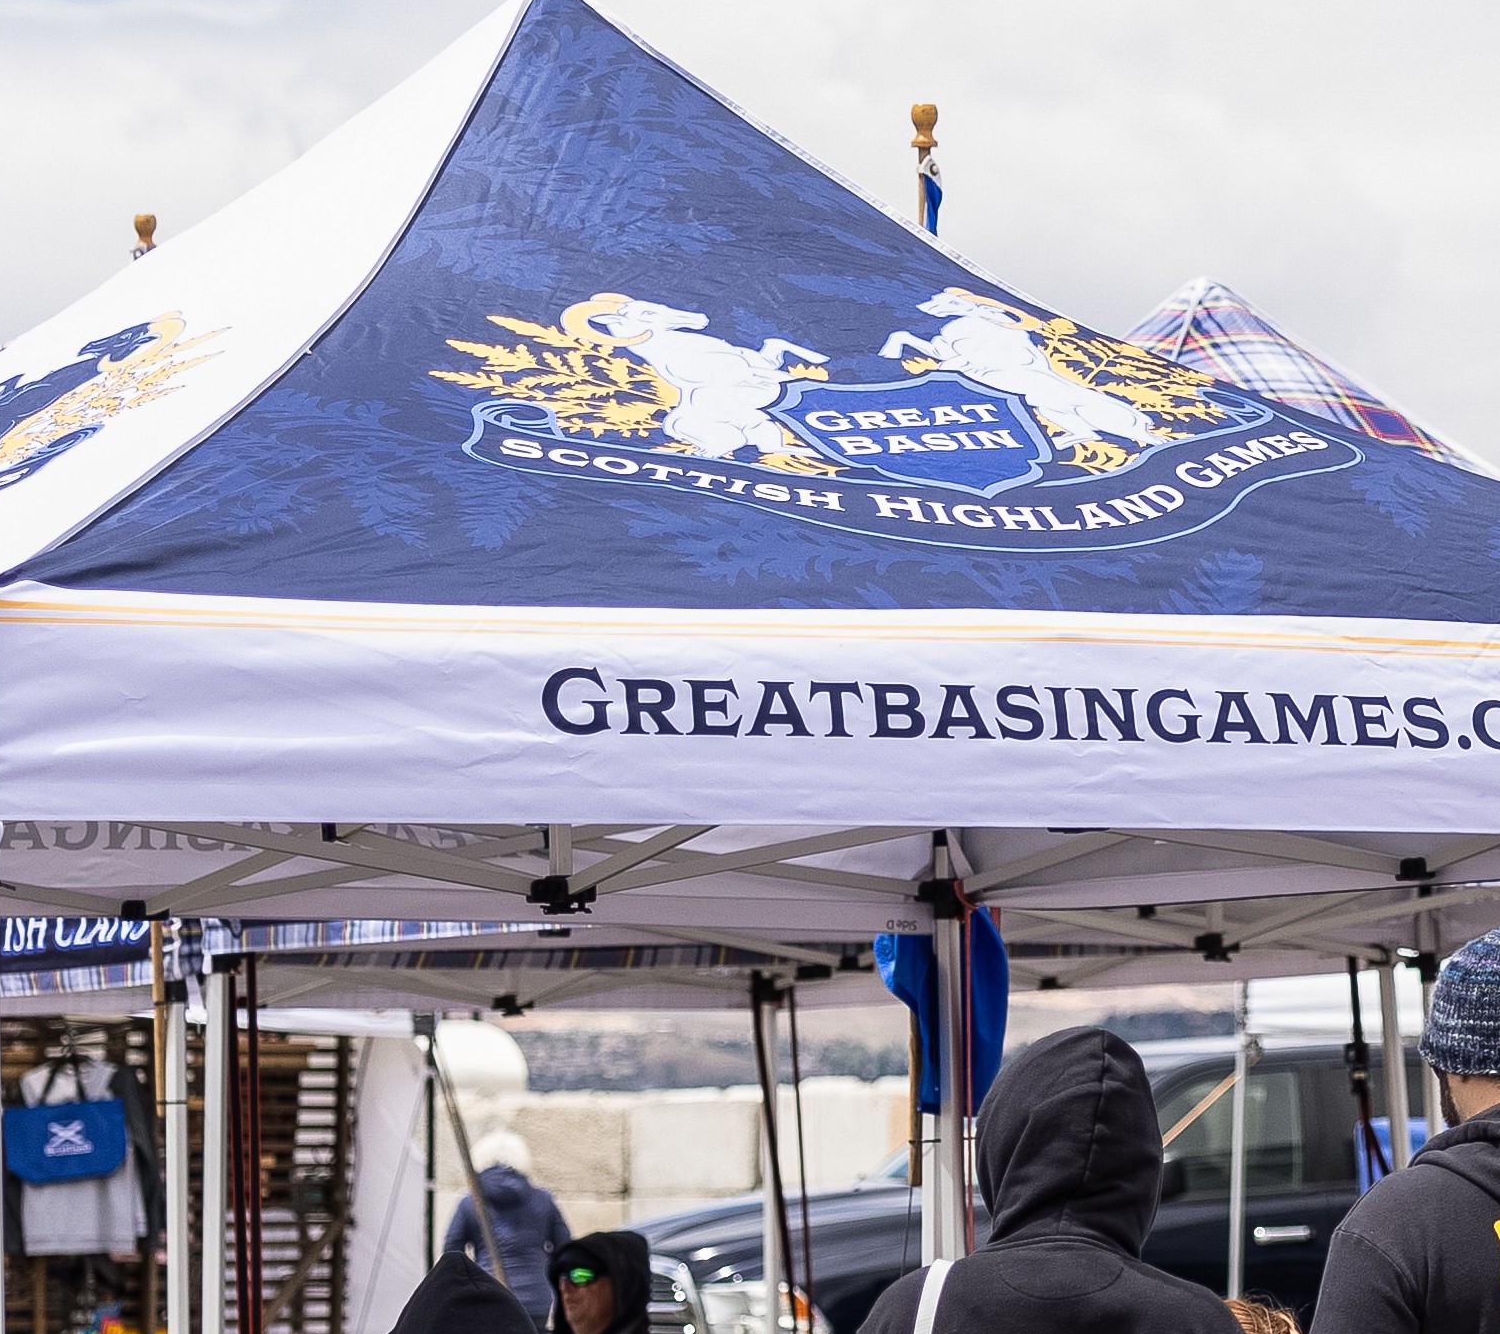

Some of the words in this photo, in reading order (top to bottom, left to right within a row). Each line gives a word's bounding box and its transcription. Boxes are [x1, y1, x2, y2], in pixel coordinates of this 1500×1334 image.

[804, 403, 1000, 432] GREAT
[830, 430, 1024, 456] BASIN
[500, 437, 846, 512] SCOTTISH
[867, 483, 1185, 532] HIGHLAND
[1174, 430, 1330, 490] GAMES
